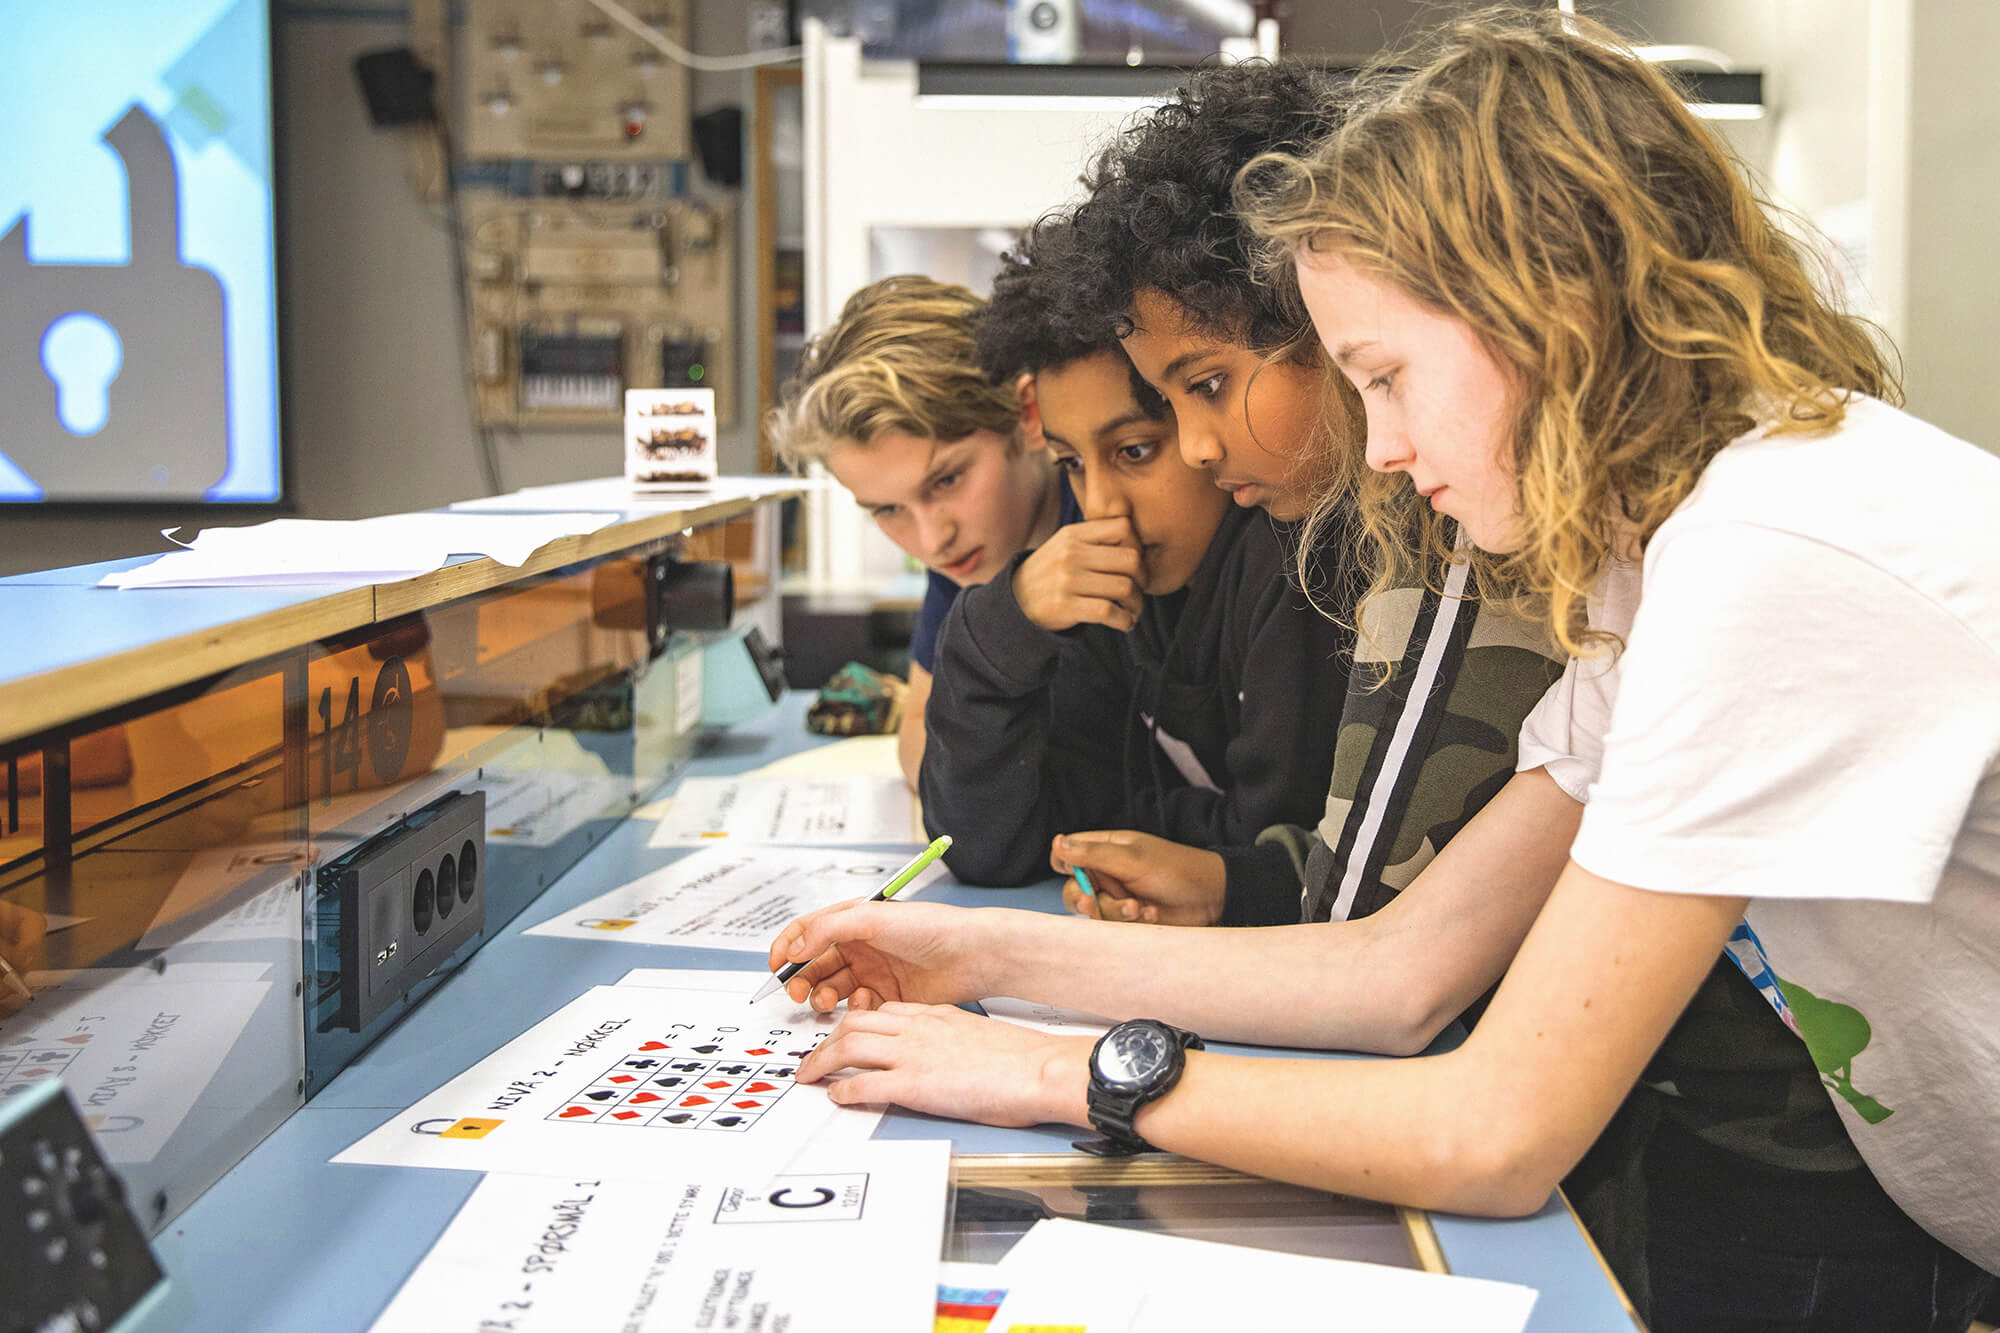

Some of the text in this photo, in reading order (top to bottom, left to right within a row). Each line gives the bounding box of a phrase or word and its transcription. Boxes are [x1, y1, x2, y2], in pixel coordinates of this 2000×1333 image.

[487, 1080, 544, 1111] NIVÅ
[563, 1018, 631, 1056] NØKKEL
[521, 1195, 595, 1273] SPØRSMÅL
[768, 1187, 836, 1209] C
